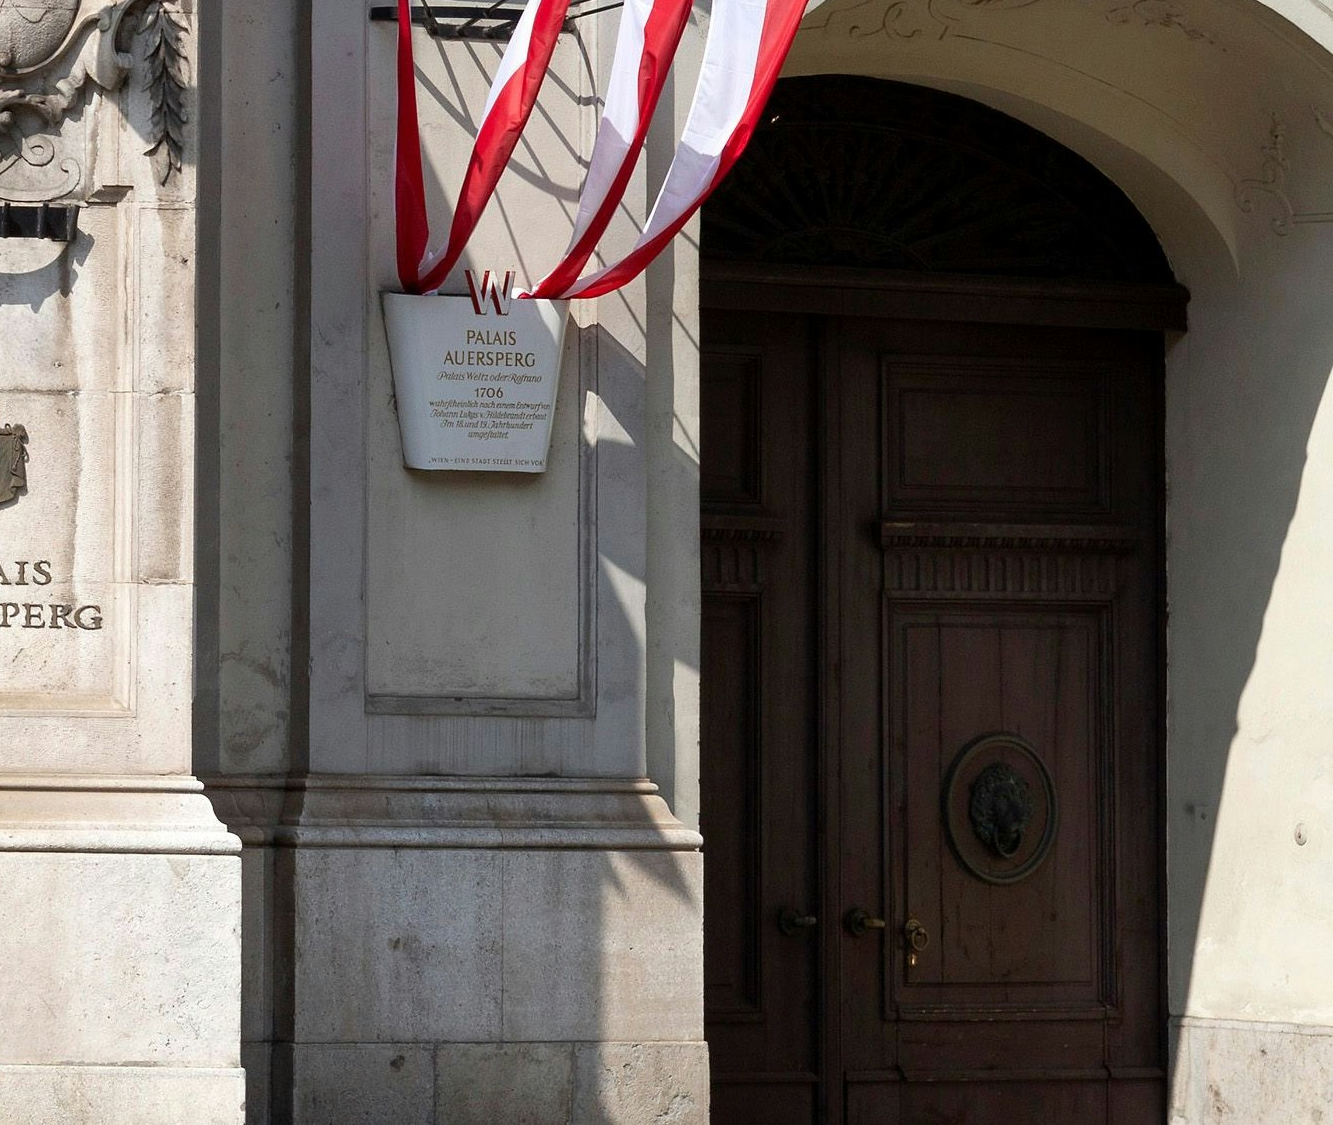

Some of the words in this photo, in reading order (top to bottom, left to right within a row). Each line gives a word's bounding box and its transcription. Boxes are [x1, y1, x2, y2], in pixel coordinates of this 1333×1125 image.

[466, 329, 517, 346] PALAIS
[443, 350, 536, 368] AUERSPERG
[475, 386, 504, 399] 1706
